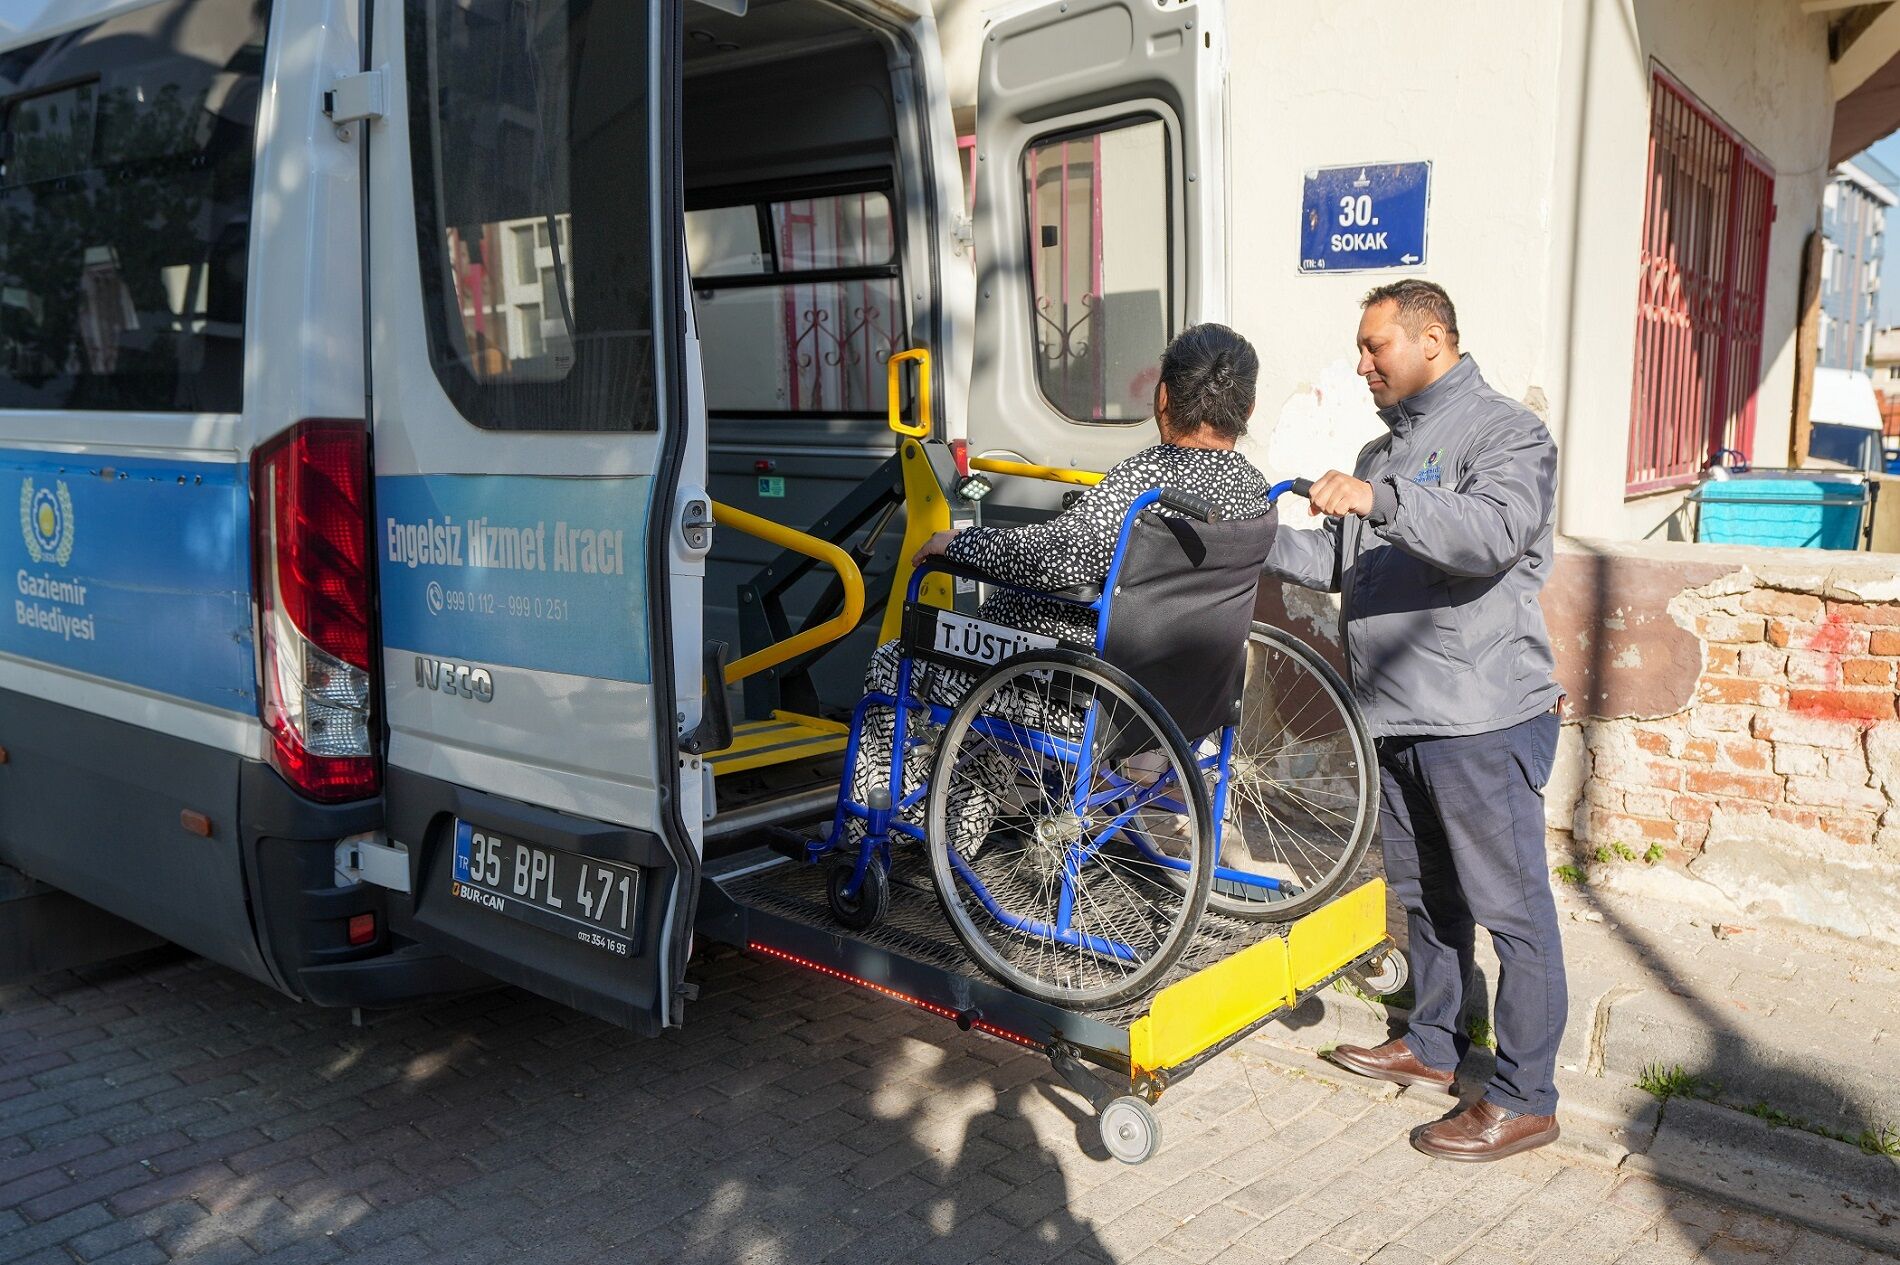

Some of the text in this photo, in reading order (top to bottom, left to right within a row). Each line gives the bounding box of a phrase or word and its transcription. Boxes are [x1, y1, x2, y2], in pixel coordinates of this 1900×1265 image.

[1339, 194, 1379, 227] 30.
[1331, 232, 1388, 252] SOKAK
[386, 515, 624, 576] Engelsiz Hizmet Aracı
[17, 568, 87, 606] Gaziemir
[446, 590, 465, 611] 999
[468, 592, 475, 611] 0
[478, 593, 495, 614] 112
[508, 595, 530, 618] 999
[534, 597, 542, 618] 0
[546, 598, 569, 621] 251
[15, 599, 95, 641] Belediyesi
[941, 622, 1041, 664] T.ÜSTÜ
[414, 656, 495, 703] IVECO
[458, 855, 469, 871] TR
[470, 832, 631, 930] 35 BPL 471
[591, 933, 606, 948] 354
[606, 939, 616, 951] 16
[616, 942, 627, 955] 93
